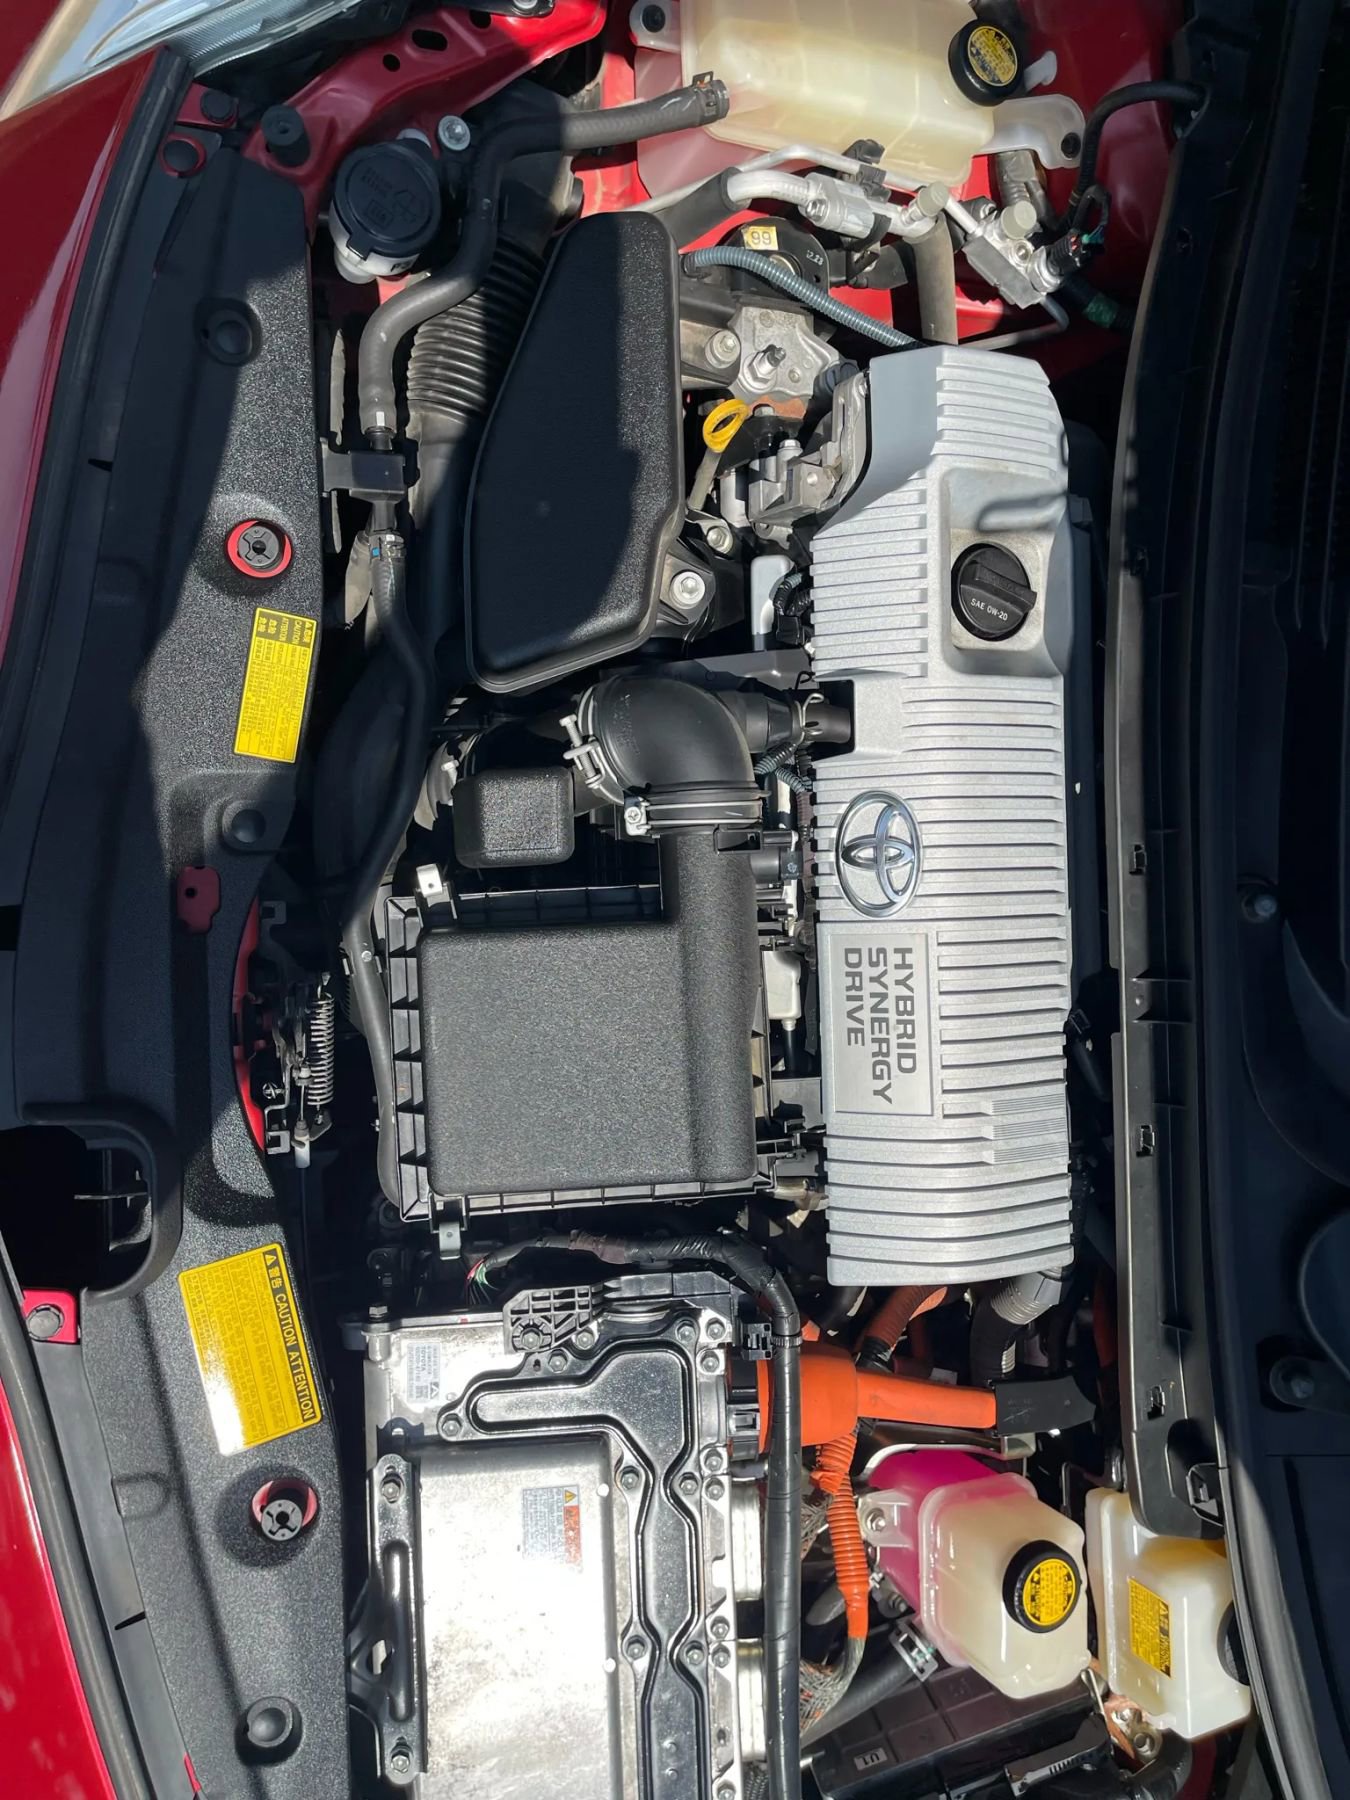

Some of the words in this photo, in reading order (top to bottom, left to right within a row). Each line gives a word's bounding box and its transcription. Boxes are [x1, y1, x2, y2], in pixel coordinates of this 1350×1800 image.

[278, 617, 289, 642] ATTENTION
[291, 619, 303, 645] CAUTION
[970, 598, 986, 611] SAE
[844, 947, 866, 1047] DRIVE
[868, 947, 893, 1104] SYNERGY
[893, 947, 917, 1073] HYBRID
[275, 1293, 297, 1346] CAUTION
[289, 1351, 314, 1419] ATTENTION
